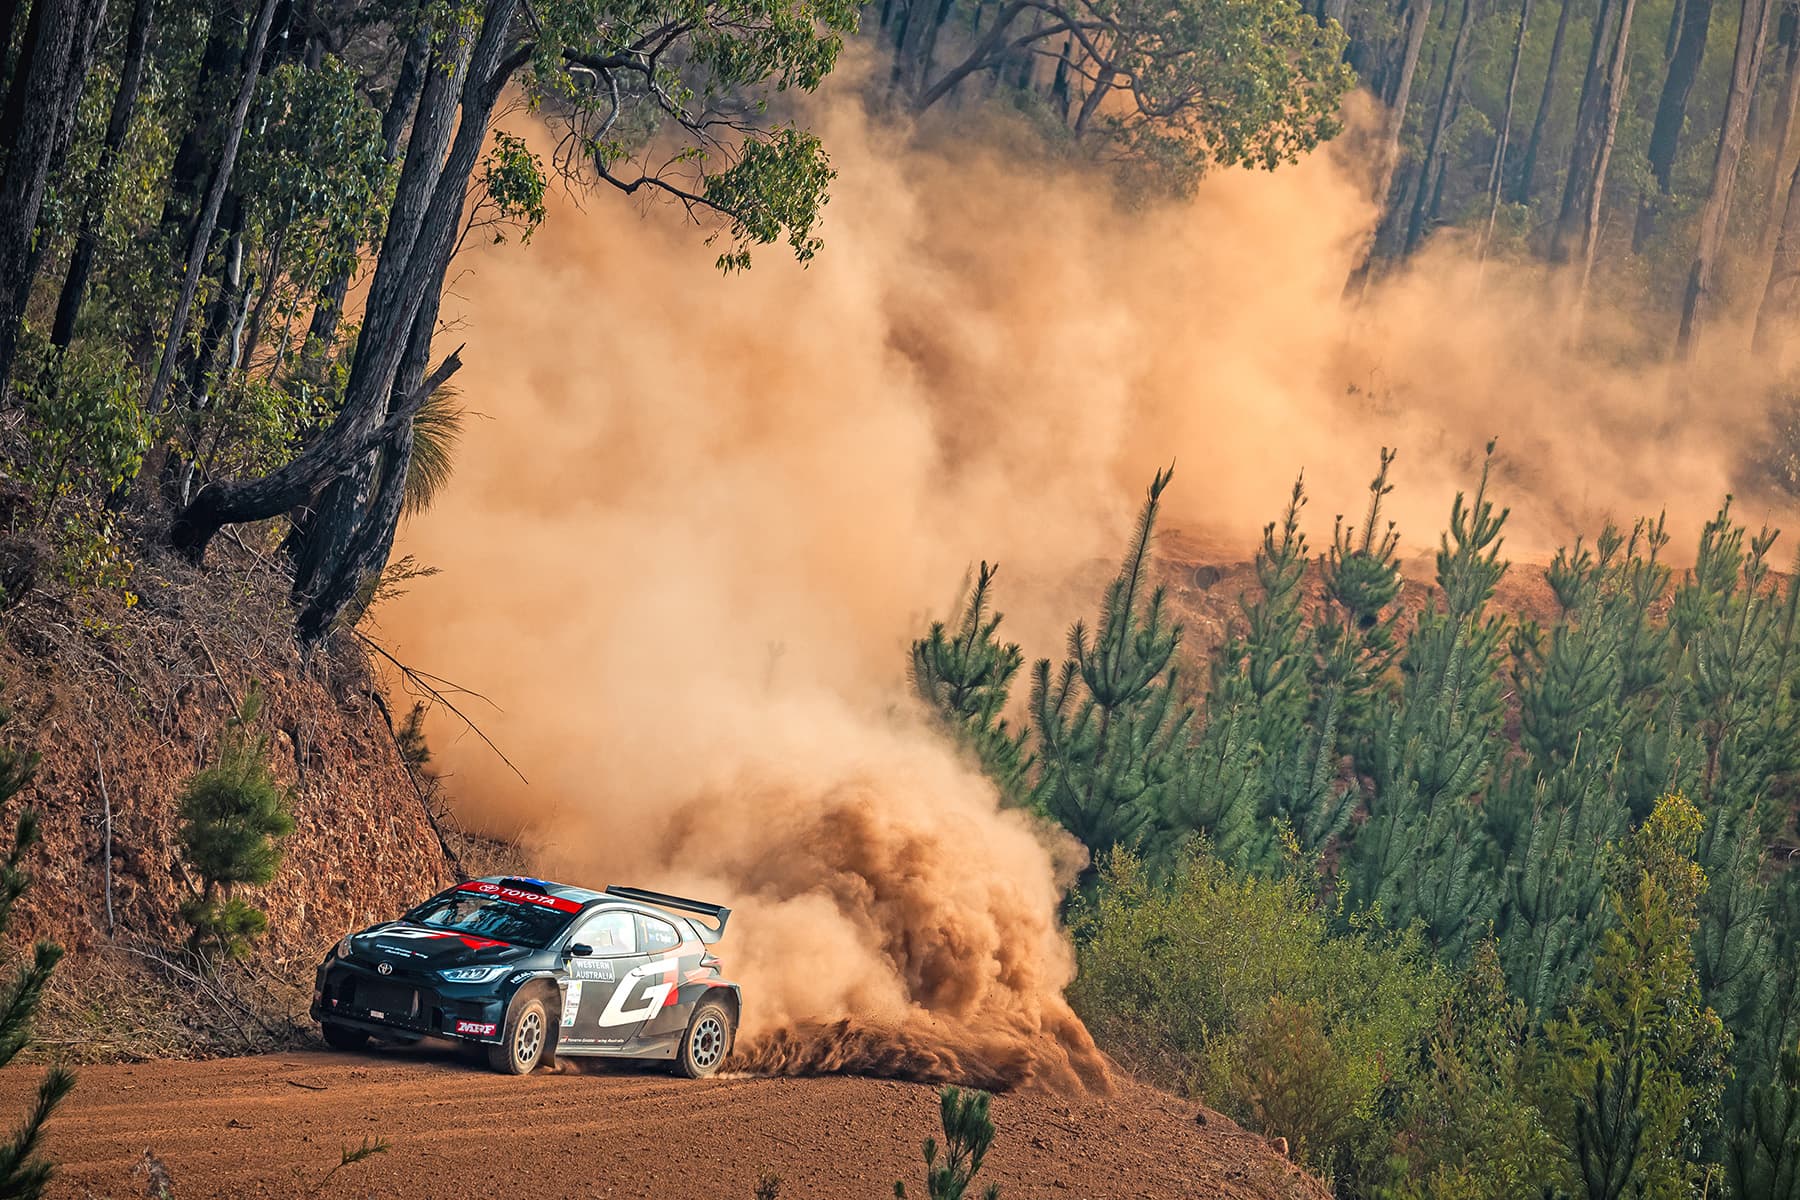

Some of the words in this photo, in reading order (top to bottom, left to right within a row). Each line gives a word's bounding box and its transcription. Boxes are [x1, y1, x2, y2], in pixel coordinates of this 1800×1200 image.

[501, 888, 555, 905] TOYOTA
[576, 960, 610, 969] WESTERN
[575, 971, 613, 980] AUSTRALIA
[458, 1022, 495, 1034] MRF
